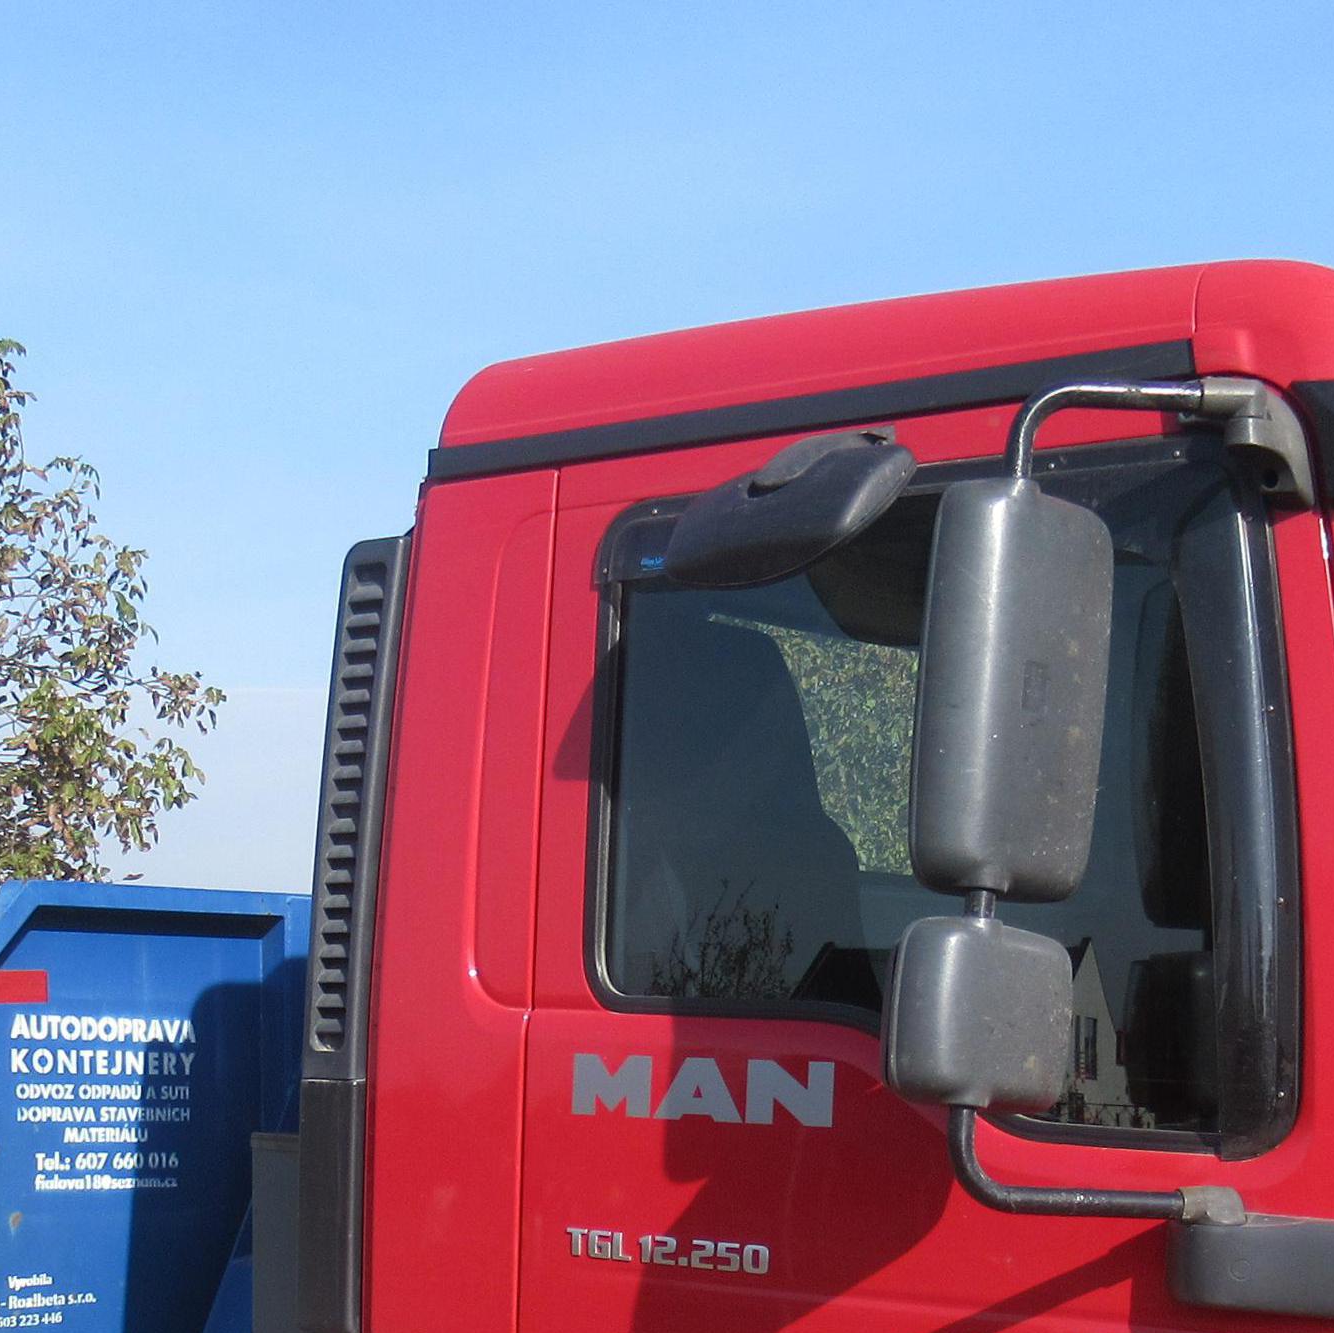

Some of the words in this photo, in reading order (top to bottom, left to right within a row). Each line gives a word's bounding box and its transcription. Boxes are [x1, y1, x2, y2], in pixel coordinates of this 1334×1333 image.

[10, 1014, 196, 1043] AUTODOPRAVA
[10, 1047, 196, 1076] KONTEJNERY
[16, 1083, 74, 1100] ODVOZ
[146, 1086, 156, 1099] A
[571, 1053, 835, 1128] MAN
[17, 1106, 97, 1123] DOPRAVA
[35, 1151, 71, 1171] Tel.:
[75, 1153, 108, 1170] 607
[113, 1152, 144, 1170] 660
[148, 1153, 179, 1169] 016
[567, 1227, 632, 1262] TGL
[638, 1234, 771, 1276] 12.250
[67, 1293, 97, 1305] s.r.o.
[19, 1314, 40, 1327] 223
